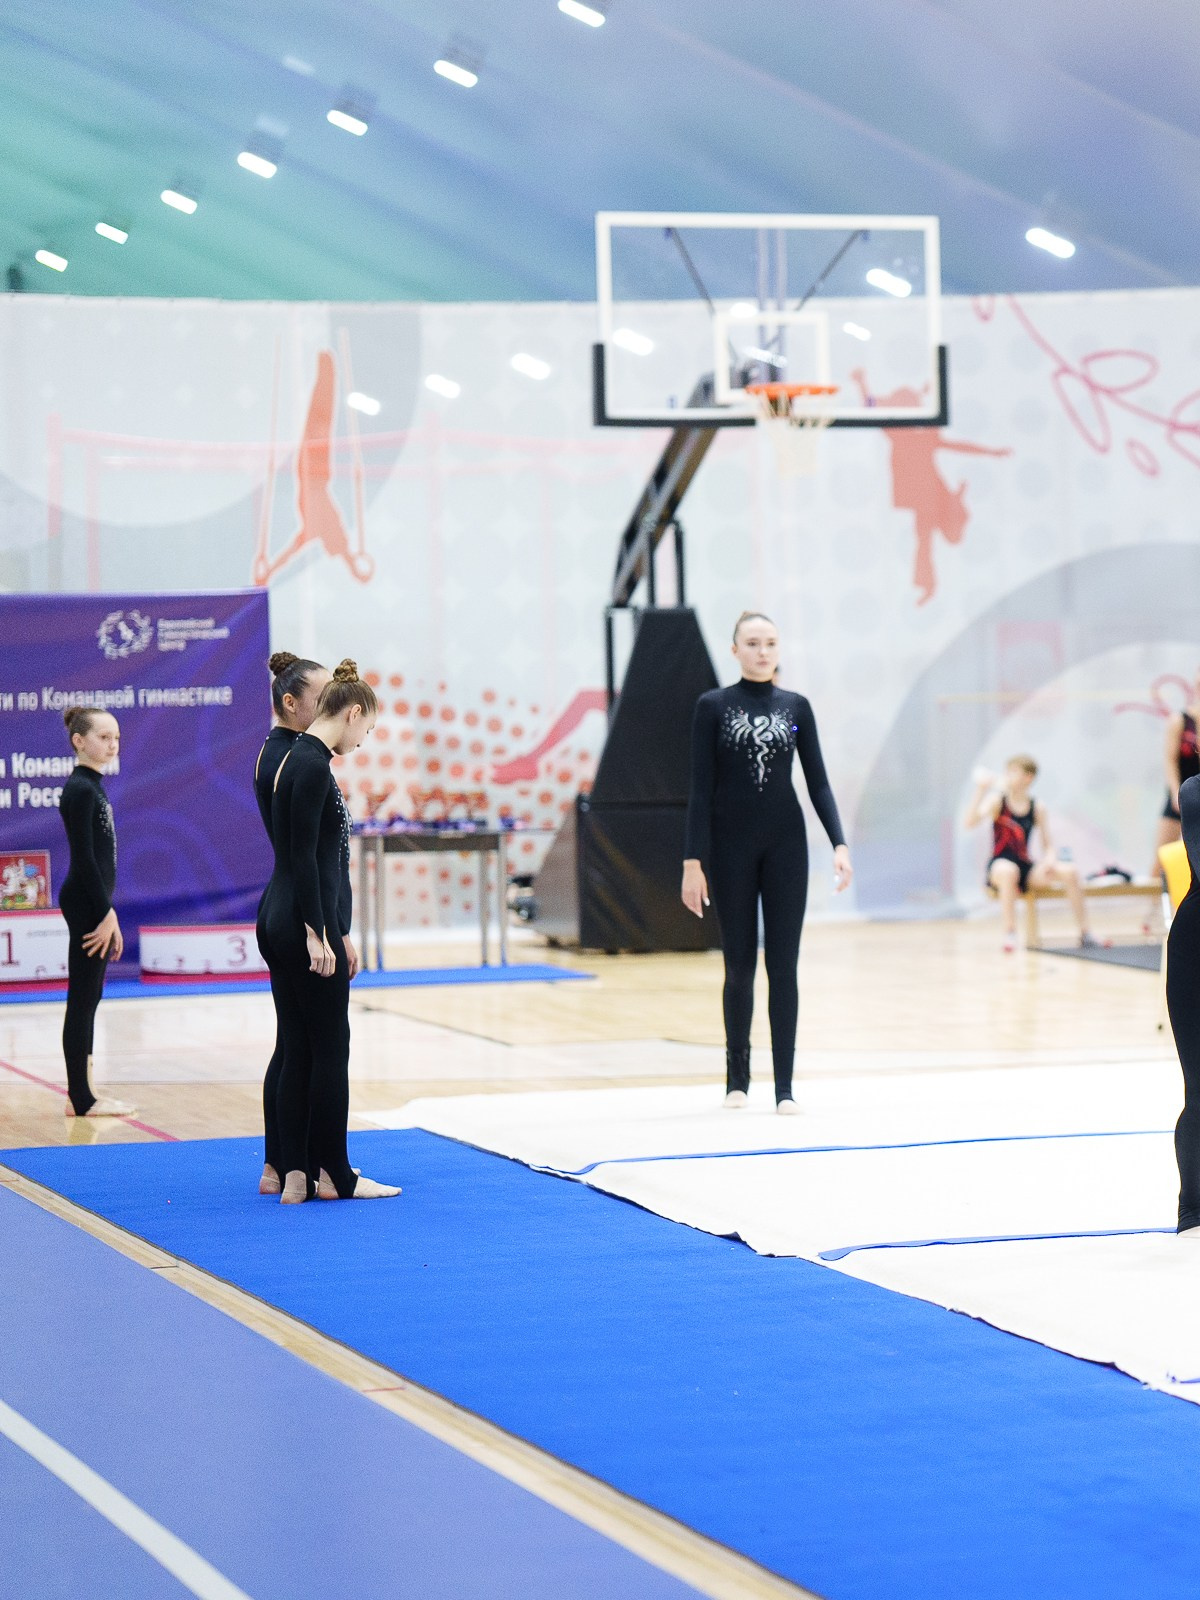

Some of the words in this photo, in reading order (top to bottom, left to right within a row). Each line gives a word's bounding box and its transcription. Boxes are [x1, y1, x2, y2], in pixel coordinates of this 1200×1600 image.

[18, 691, 38, 711] по
[42, 686, 135, 710] Командной
[18, 782, 63, 808] Росс
[1, 929, 19, 966] 1
[226, 935, 247, 967] 3
